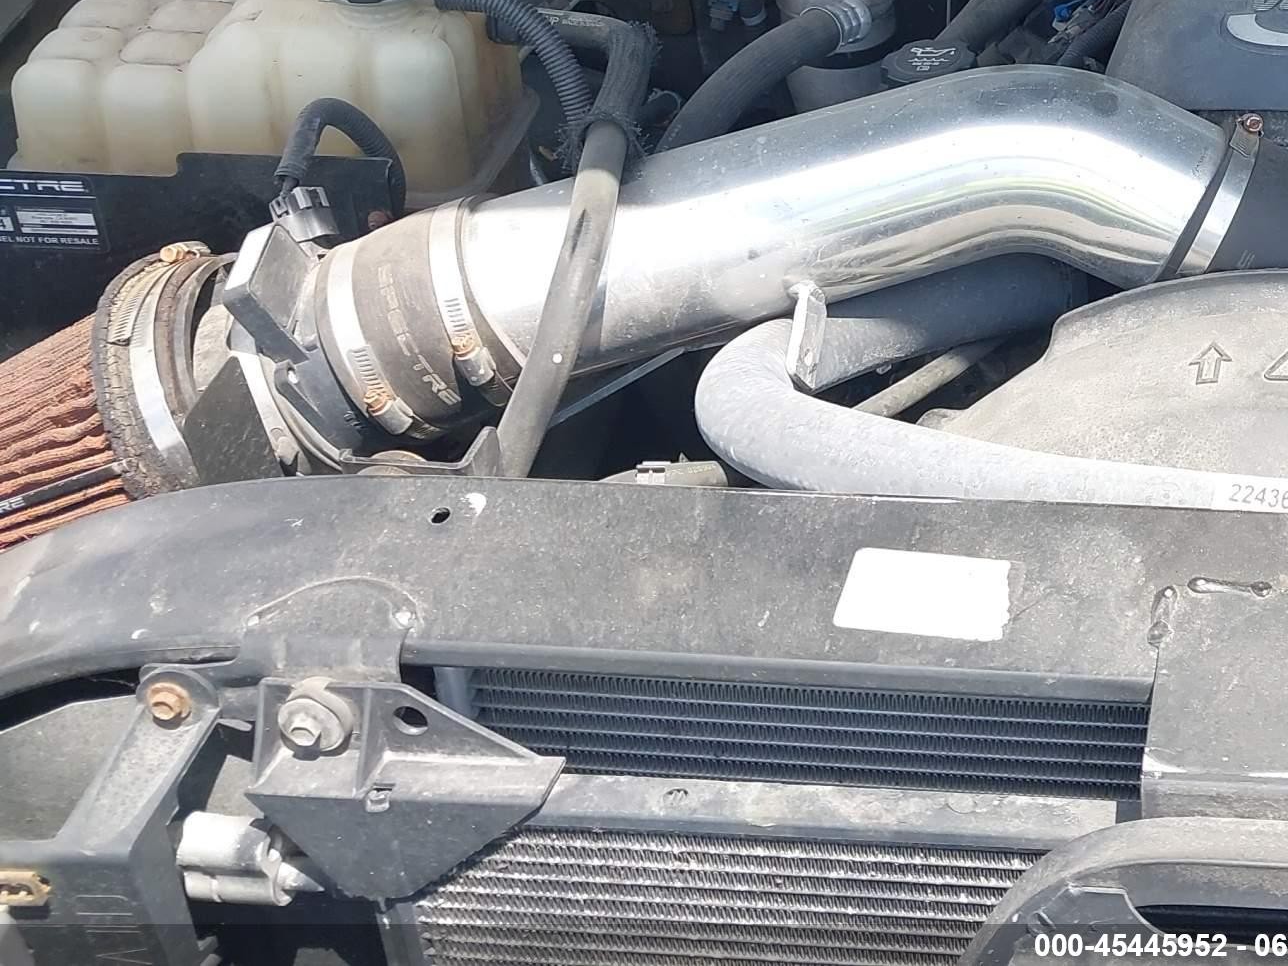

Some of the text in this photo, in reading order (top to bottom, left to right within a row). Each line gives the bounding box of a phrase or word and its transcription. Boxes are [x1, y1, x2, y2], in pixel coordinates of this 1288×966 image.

[15, 236, 36, 244] NOT
[38, 236, 59, 244] FOR
[59, 237, 99, 245] RESALE
